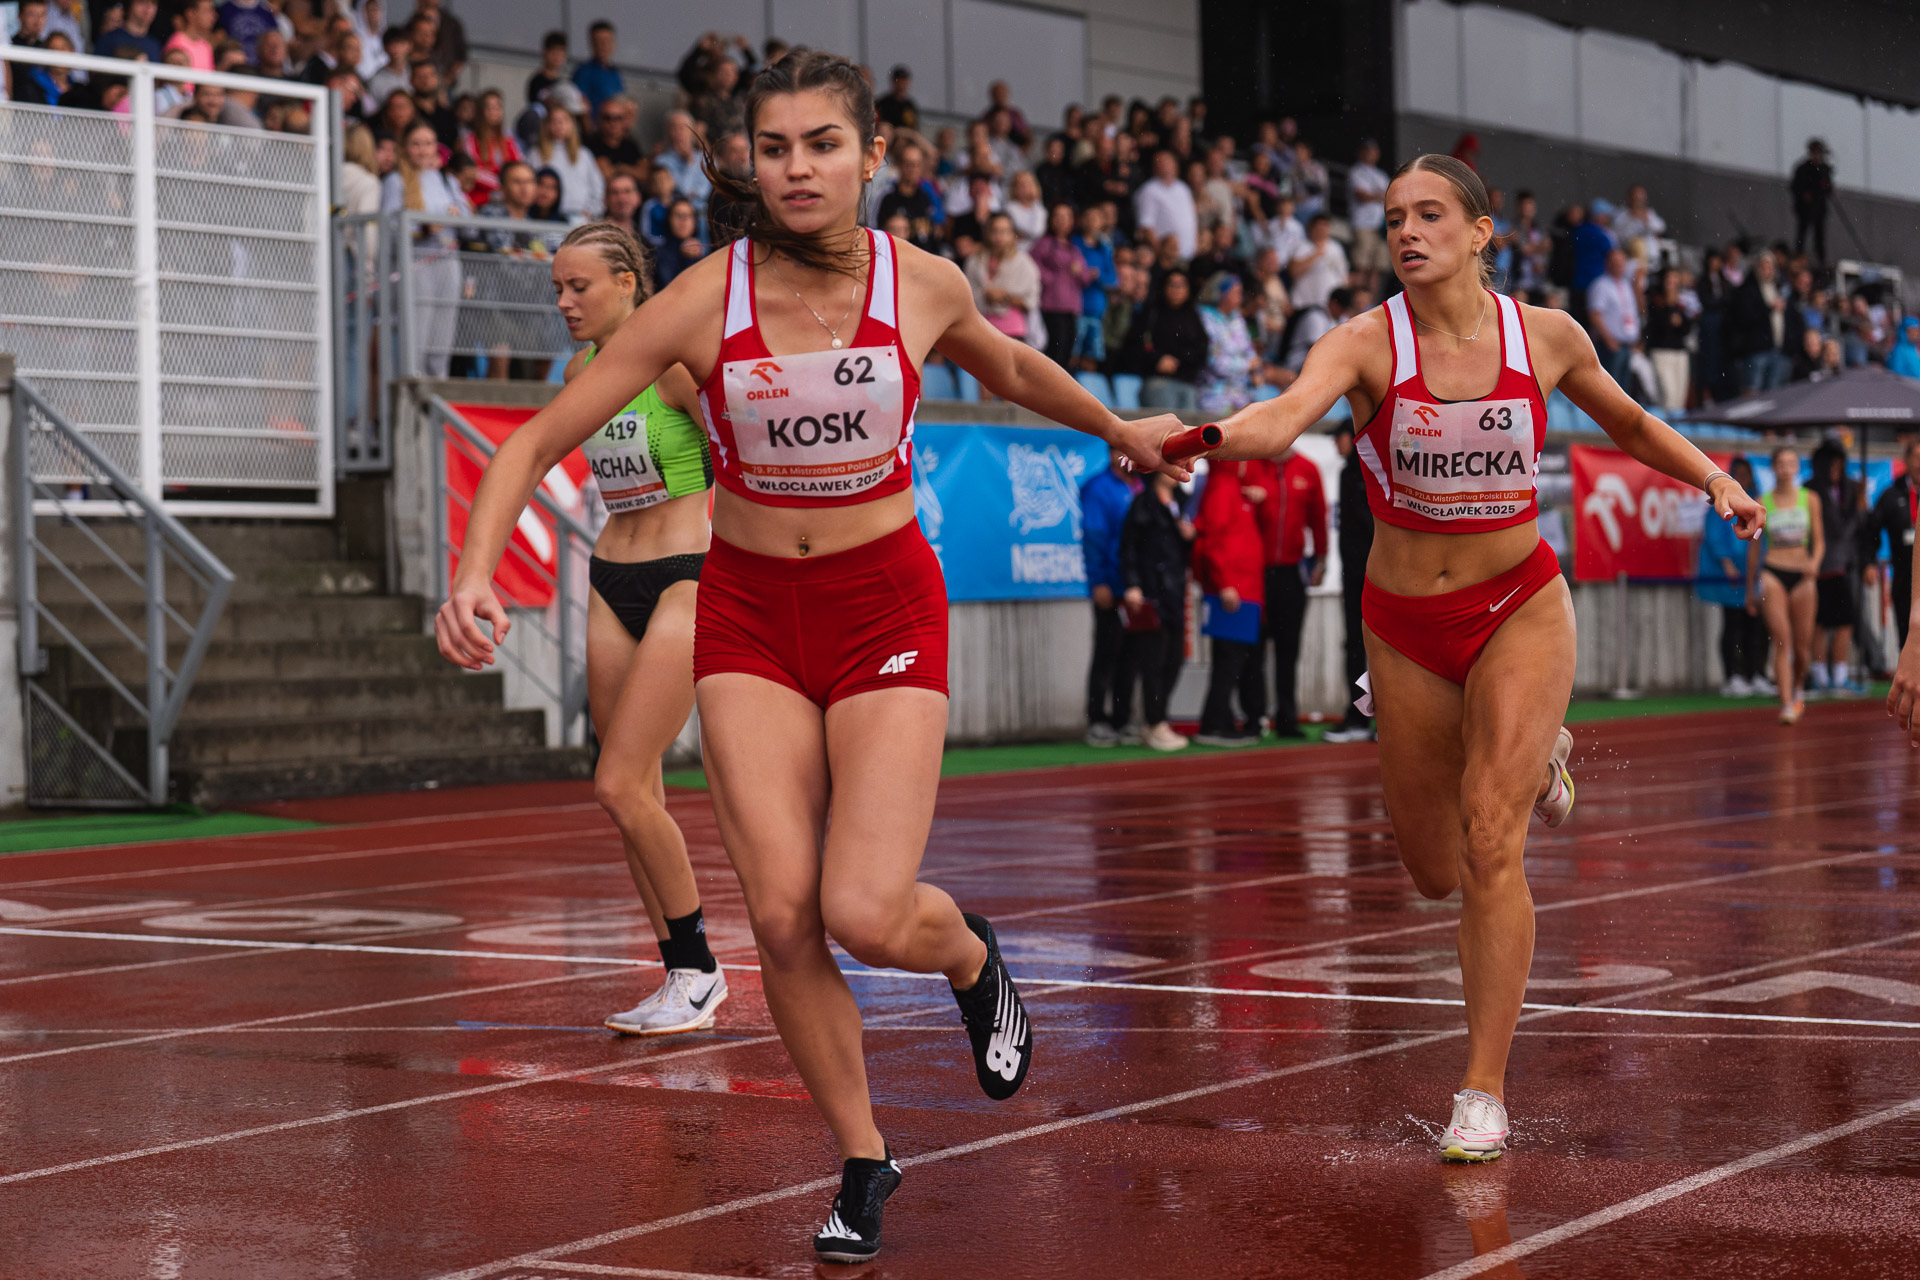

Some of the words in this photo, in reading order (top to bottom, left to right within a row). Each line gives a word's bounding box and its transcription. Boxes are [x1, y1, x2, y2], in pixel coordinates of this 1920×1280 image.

[833, 355, 876, 386] 62
[746, 387, 789, 401] ORLEN
[604, 420, 637, 441] 419
[767, 409, 869, 448] KOSK
[1478, 407, 1513, 431] 63
[1407, 426, 1442, 437] ORLEN
[588, 454, 648, 479] ACHAJ
[767, 467, 787, 475] PZLA
[789, 465, 846, 476] Mistrzostwa
[847, 458, 873, 472] Polski
[875, 454, 889, 466] U20
[1396, 448, 1527, 479] MIRECKA
[756, 479, 853, 492] WŁOCŁAWEK
[855, 468, 884, 488] 2025
[634, 494, 658, 506] 2025
[1406, 499, 1482, 517] WŁOCŁAWEK
[1485, 504, 1516, 515] 2025
[1415, 491, 1431, 501] PZLA
[1432, 494, 1478, 503] Mistrzostwa
[1479, 493, 1502, 501] Polski
[878, 650, 919, 675] 4F
